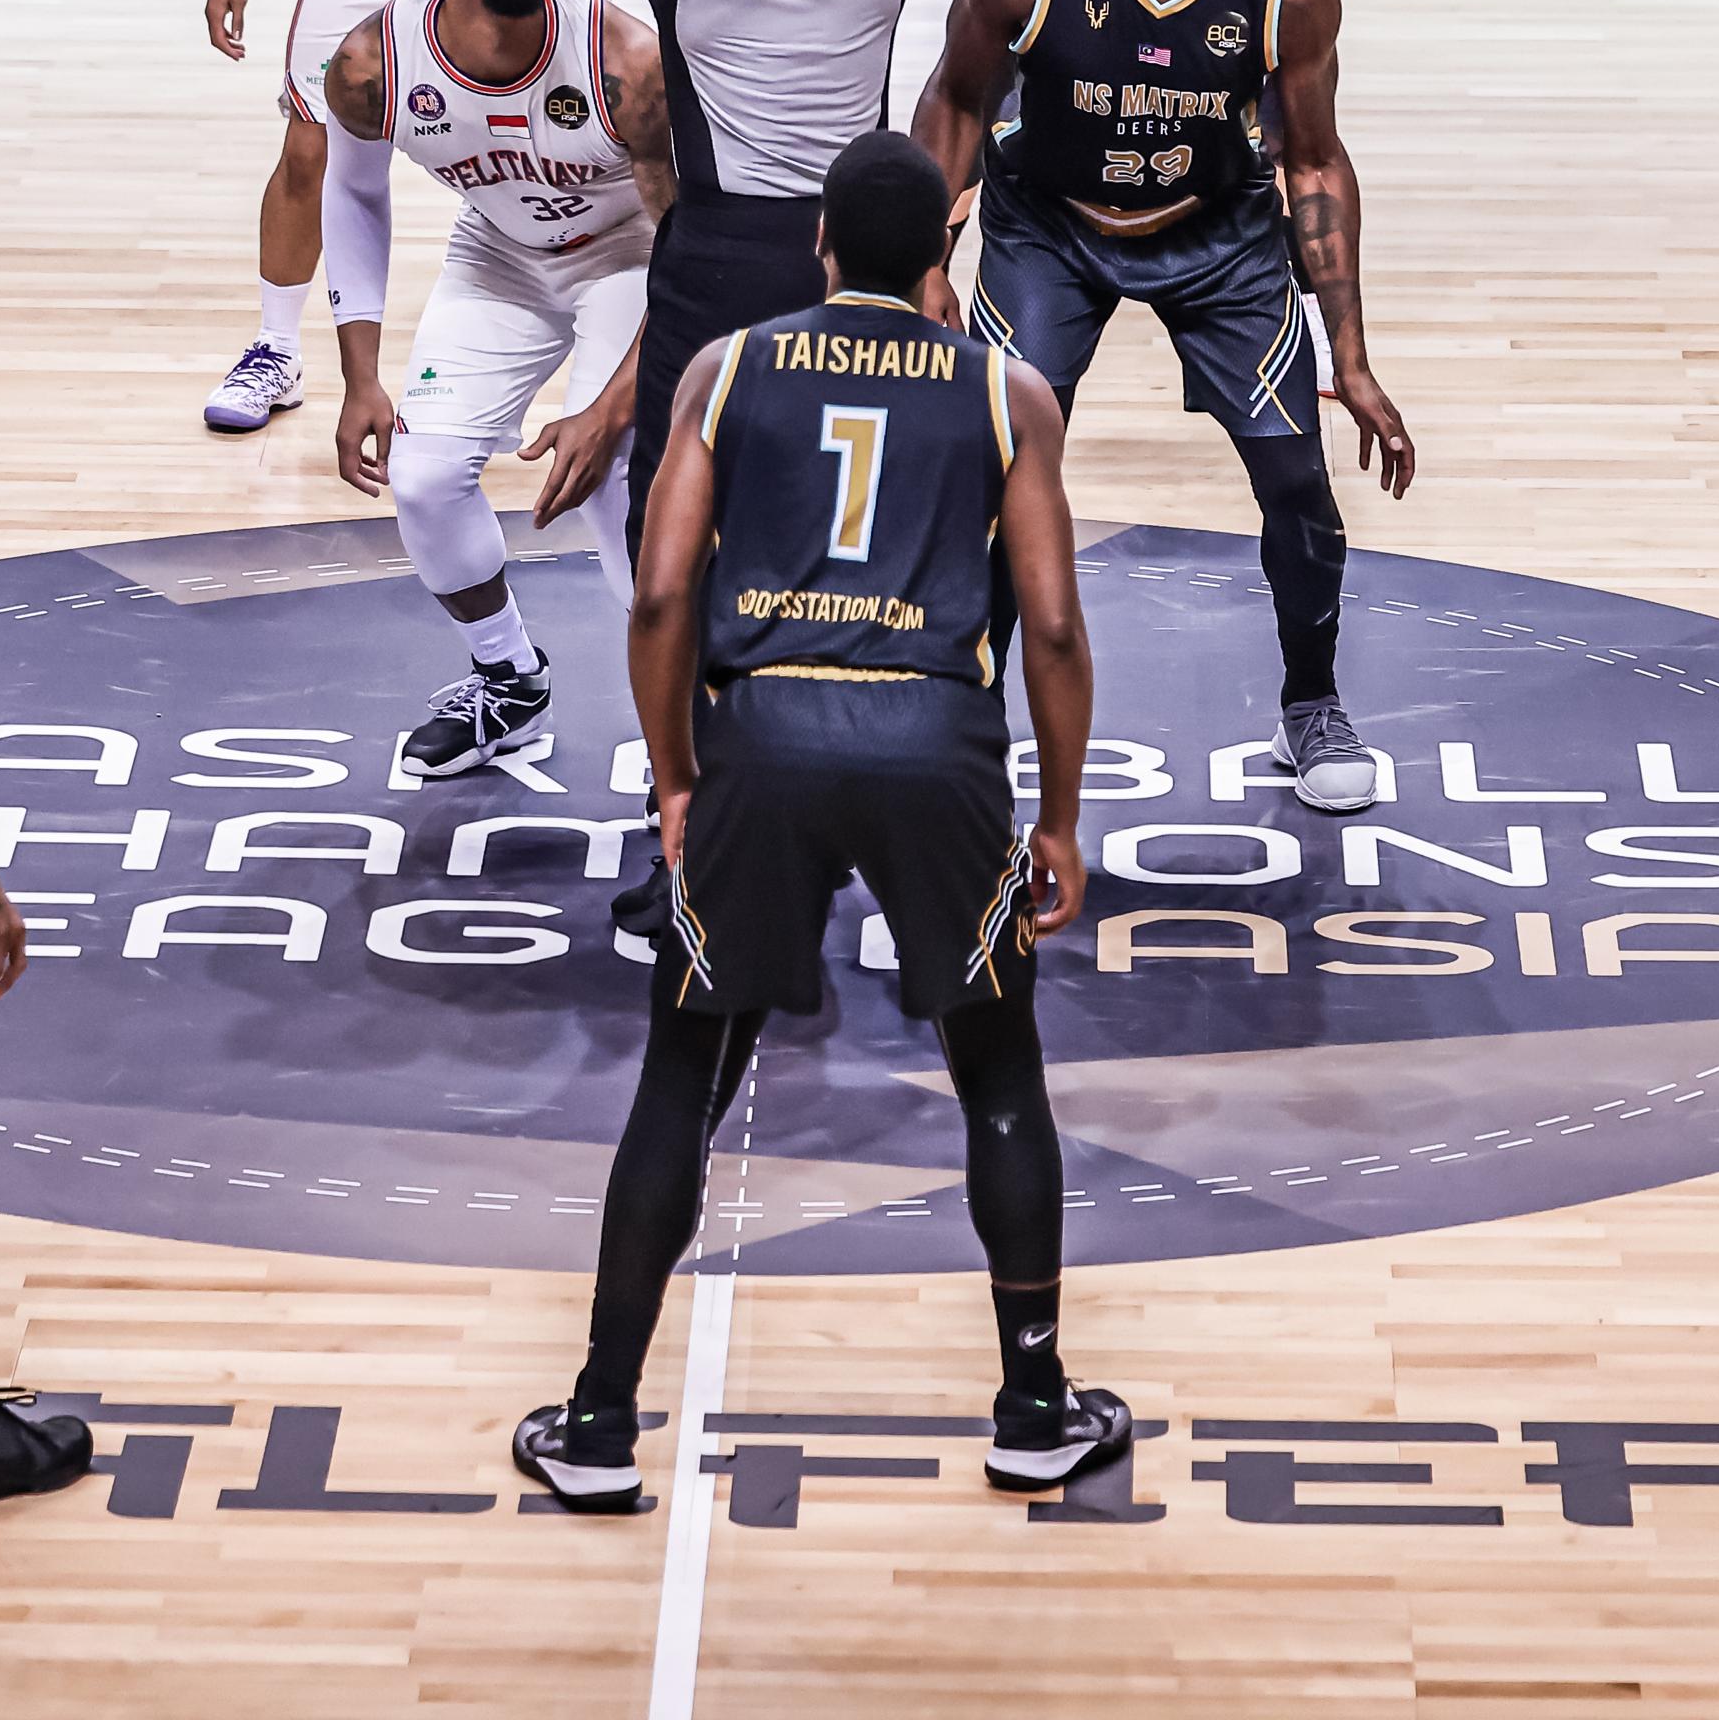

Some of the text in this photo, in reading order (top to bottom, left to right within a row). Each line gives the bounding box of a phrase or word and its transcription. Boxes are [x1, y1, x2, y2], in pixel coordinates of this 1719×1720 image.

[1207, 25, 1248, 43] BCL
[548, 99, 589, 117] BCL
[1074, 79, 1231, 121] NS MATRIX
[1117, 120, 1182, 136] DEERS
[434, 149, 547, 191] PELITA
[1101, 144, 1193, 187] 29
[519, 195, 594, 222] 32
[772, 331, 957, 382] TAISHAUN
[820, 403, 889, 563] 1
